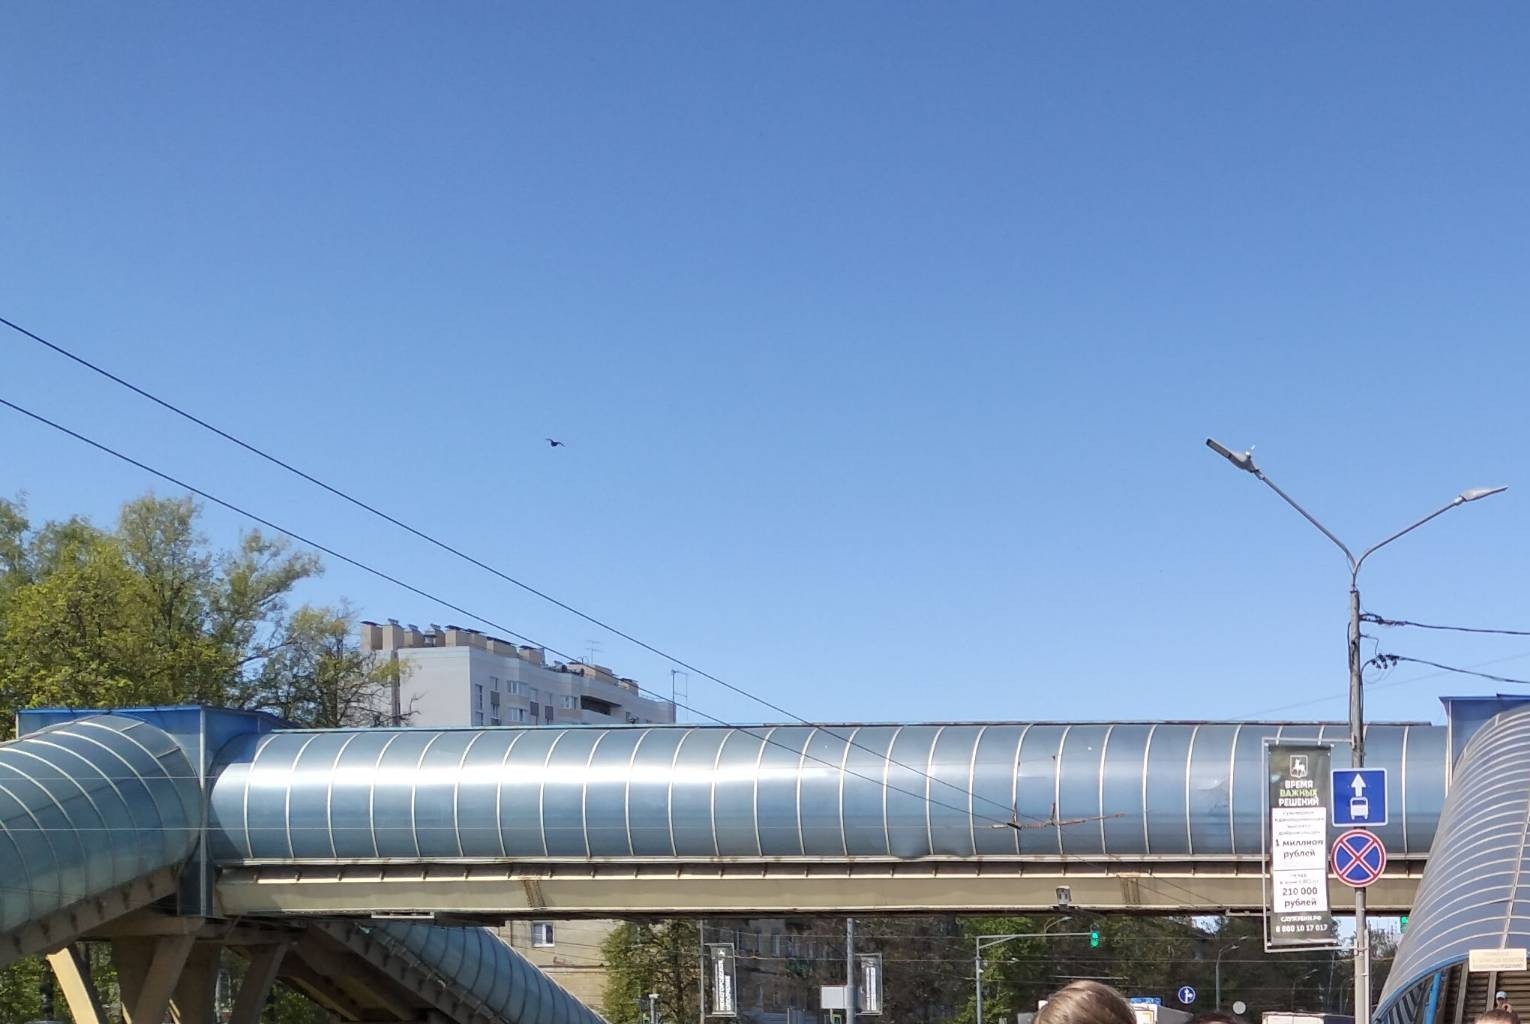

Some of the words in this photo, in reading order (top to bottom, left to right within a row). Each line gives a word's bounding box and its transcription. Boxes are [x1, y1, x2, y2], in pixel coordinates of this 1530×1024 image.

[1284, 780, 1313, 789] ВРЕМЯ
[1278, 796, 1319, 807] РЕШЕНИЙ
[1283, 839, 1324, 847] миллион
[1283, 849, 1316, 859] рублей
[1282, 887, 1298, 896] 210
[1300, 886, 1318, 895] 000
[1284, 897, 1317, 909] рублей
